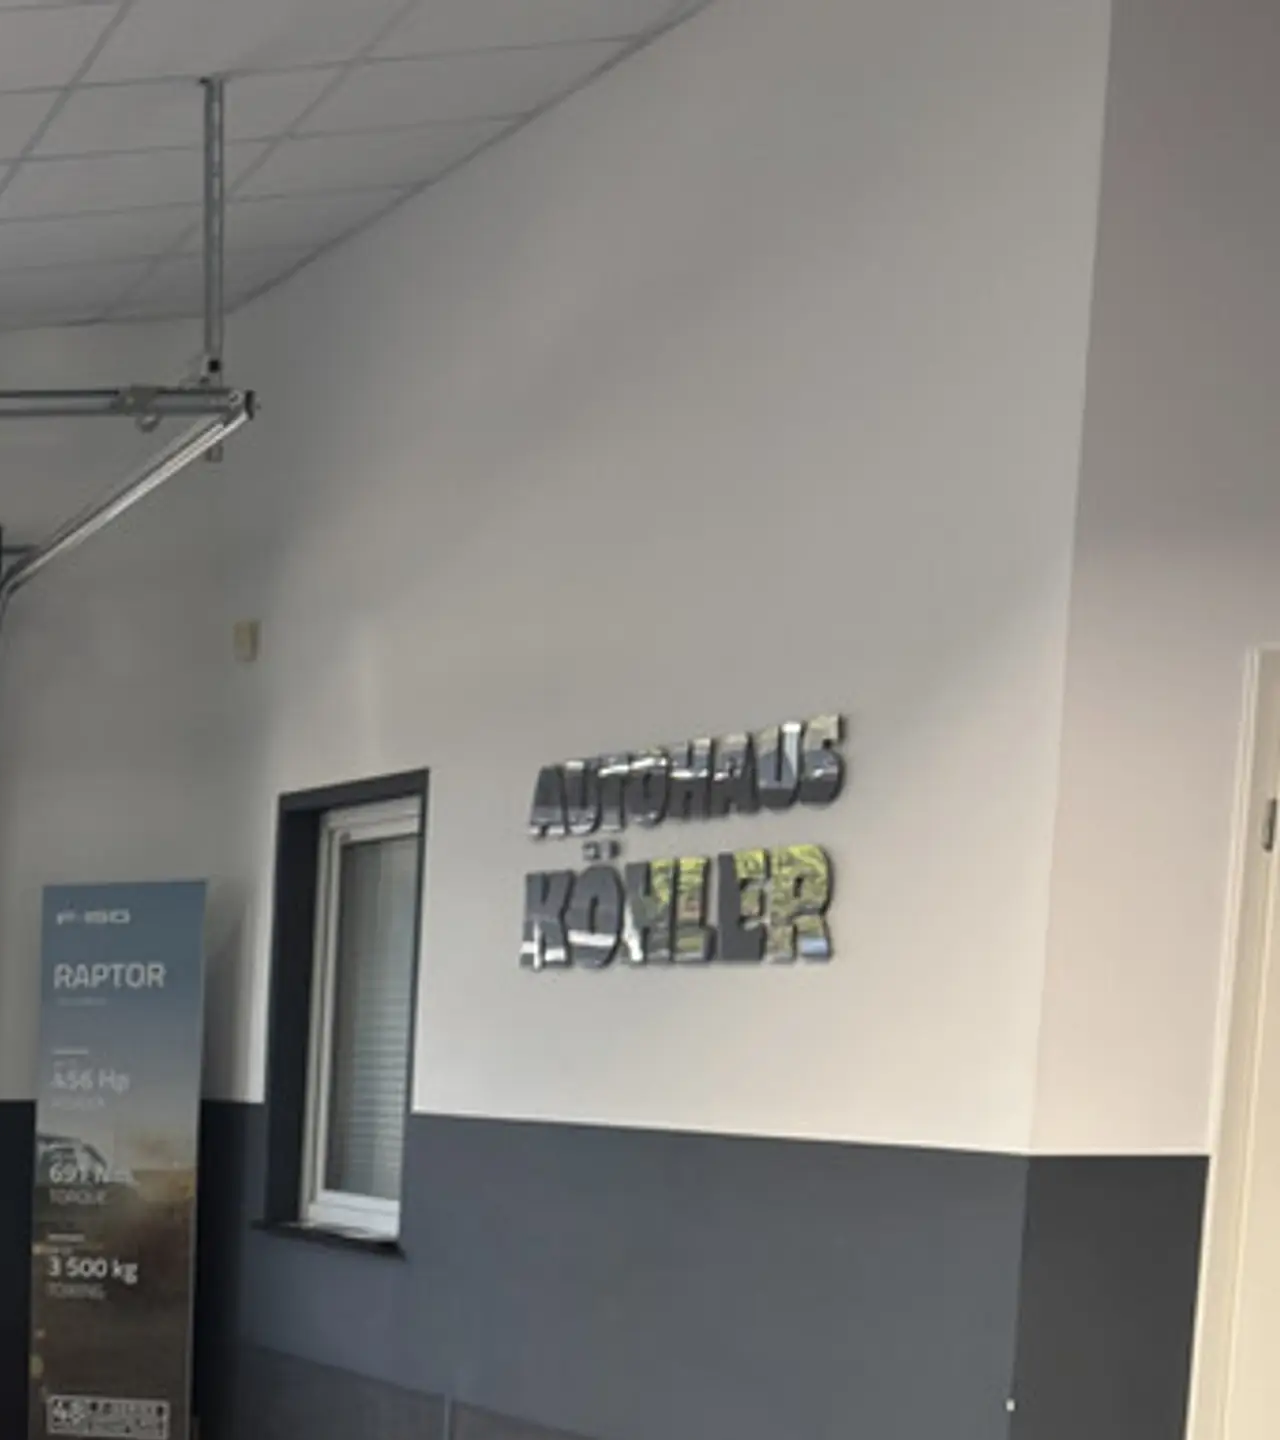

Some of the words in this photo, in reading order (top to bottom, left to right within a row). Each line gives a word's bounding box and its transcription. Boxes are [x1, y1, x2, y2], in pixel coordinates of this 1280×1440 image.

[528, 713, 846, 839] AUTOHAUS
[519, 840, 833, 970] KÖHLER
[52, 961, 167, 991] RAPTOR
[64, 1256, 108, 1279] 500
[110, 1256, 139, 1285] kg
